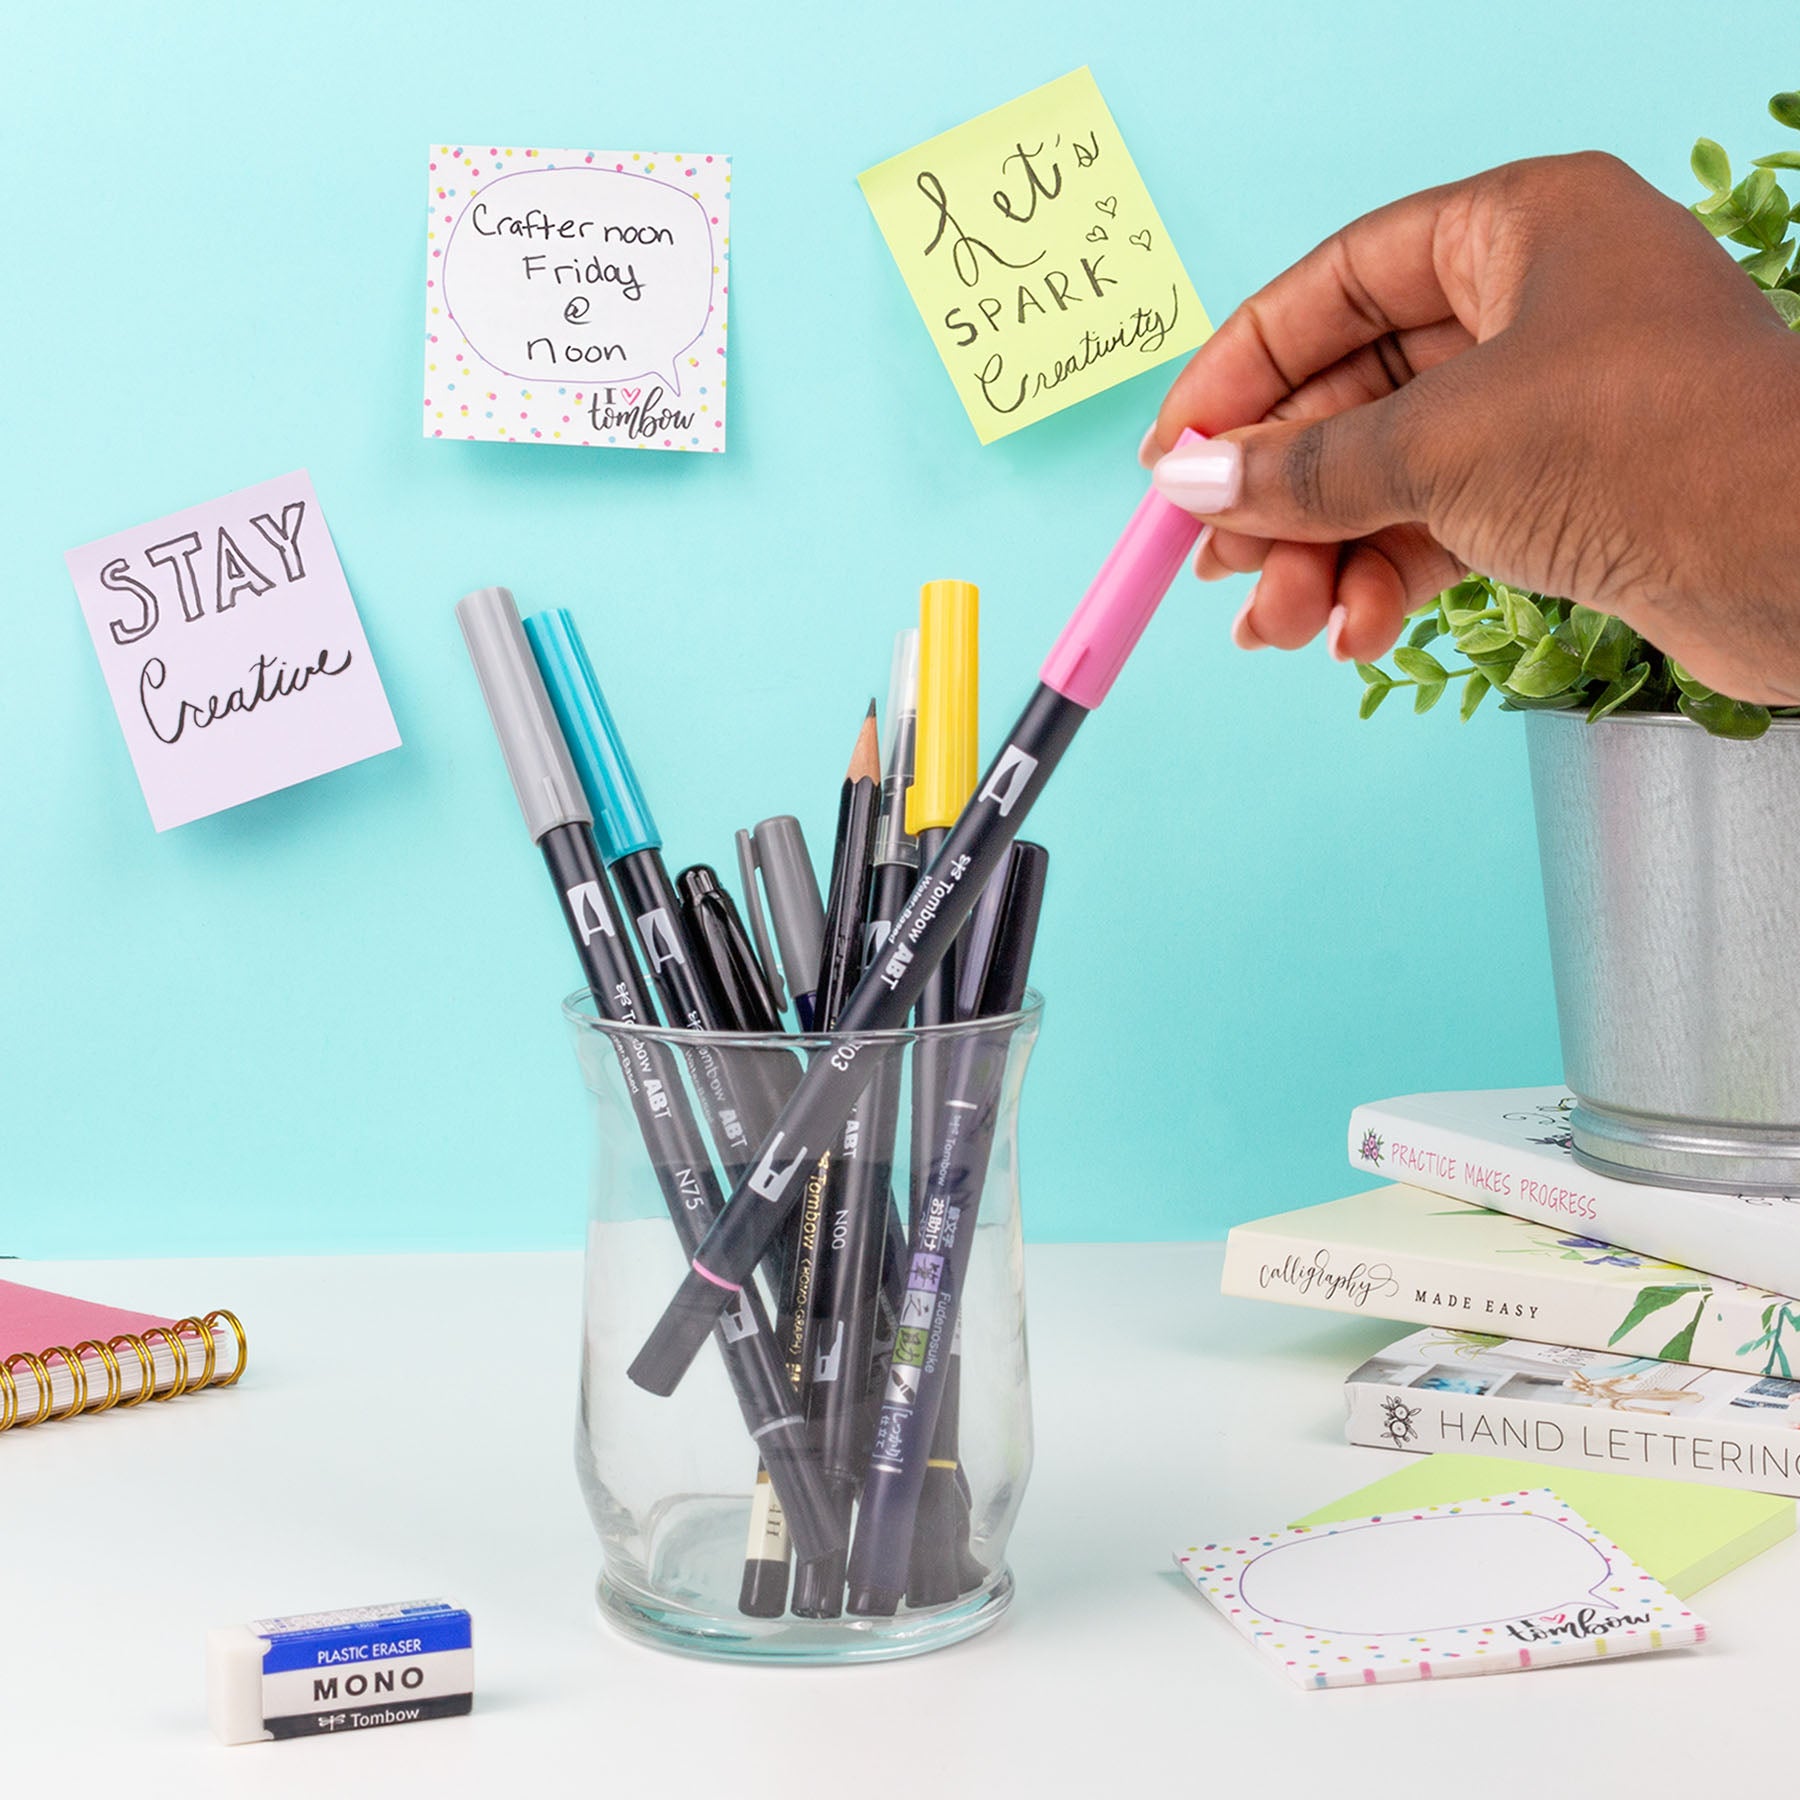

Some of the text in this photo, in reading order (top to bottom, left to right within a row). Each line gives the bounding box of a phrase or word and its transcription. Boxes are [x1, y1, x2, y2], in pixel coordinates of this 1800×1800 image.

[917, 131, 1099, 287] Let's
[522, 255, 646, 301] Friday
[563, 296, 592, 325] @
[944, 255, 1118, 346] SPARK
[974, 283, 1178, 413] Creativity
[588, 386, 695, 439] tombow
[100, 501, 306, 645] STAY
[140, 649, 352, 744] Creative
[880, 880, 954, 990] Tombow ABT
[697, 1045, 748, 1147] ombow ABT
[643, 1079, 672, 1119] ABT
[675, 1168, 704, 1211] N75
[938, 1138, 956, 1186] Tombow
[1391, 1141, 1598, 1220] PRACTICE MAKES PROGRESS
[803, 1175, 827, 1250] Tombow
[831, 1120, 860, 1250] ABT N00
[925, 1291, 952, 1373] Fudenosuke
[1414, 1289, 1472, 1310] MADE
[1485, 1299, 1540, 1320] EASY
[1440, 1411, 1564, 1452] HAND
[313, 1667, 424, 1702] MONO
[317, 1638, 422, 1664] PLASTIC ERASER
[350, 1708, 421, 1728] Tombow
